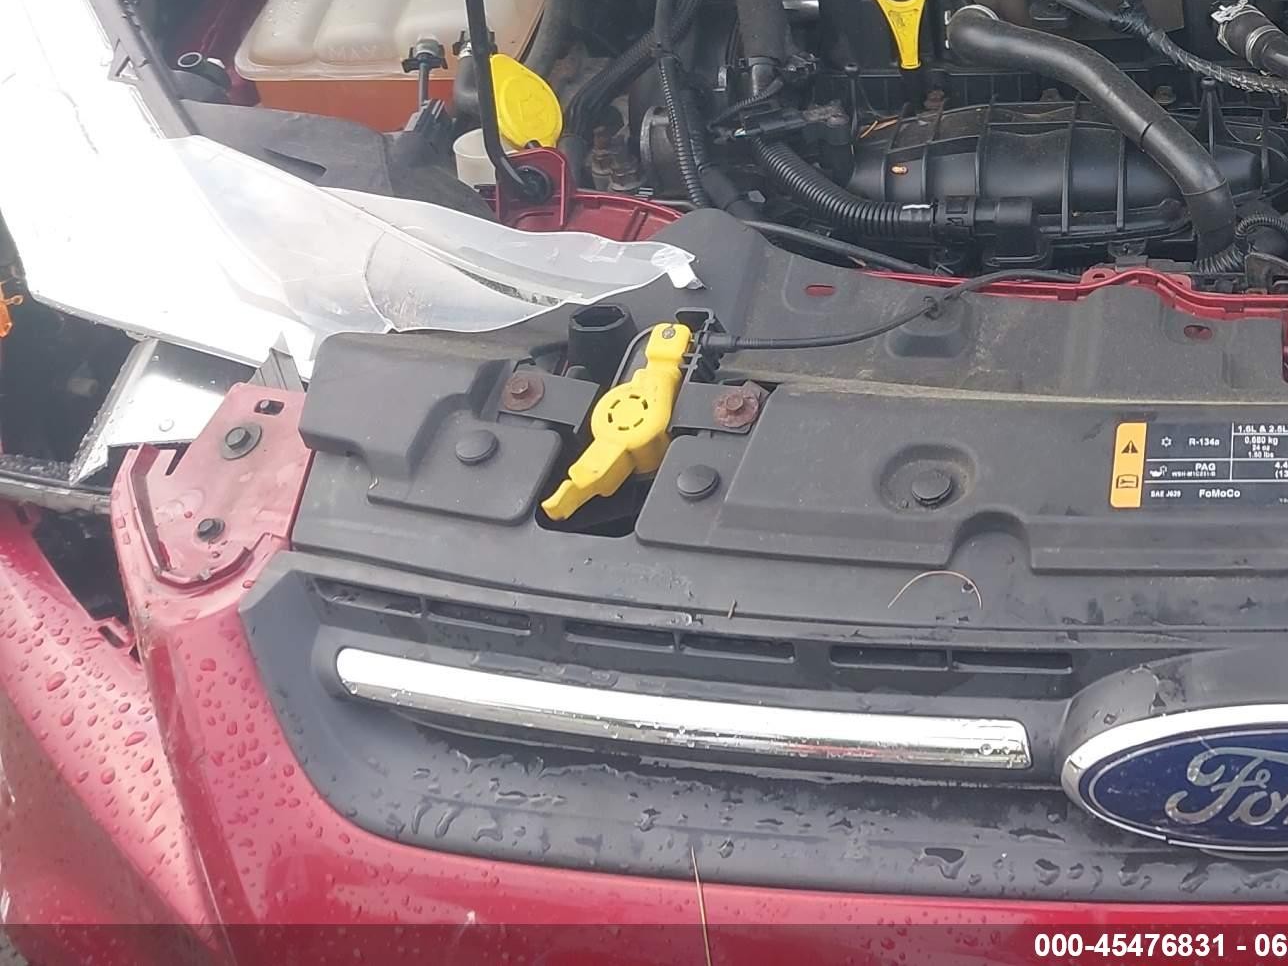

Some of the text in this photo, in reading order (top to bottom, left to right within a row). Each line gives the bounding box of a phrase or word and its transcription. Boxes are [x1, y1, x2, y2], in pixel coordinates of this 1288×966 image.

[1188, 437, 1220, 447] R-134a
[1195, 462, 1217, 472] PAG
[1274, 461, 1288, 470] 4.4
[1199, 489, 1241, 498] FoMoCo
